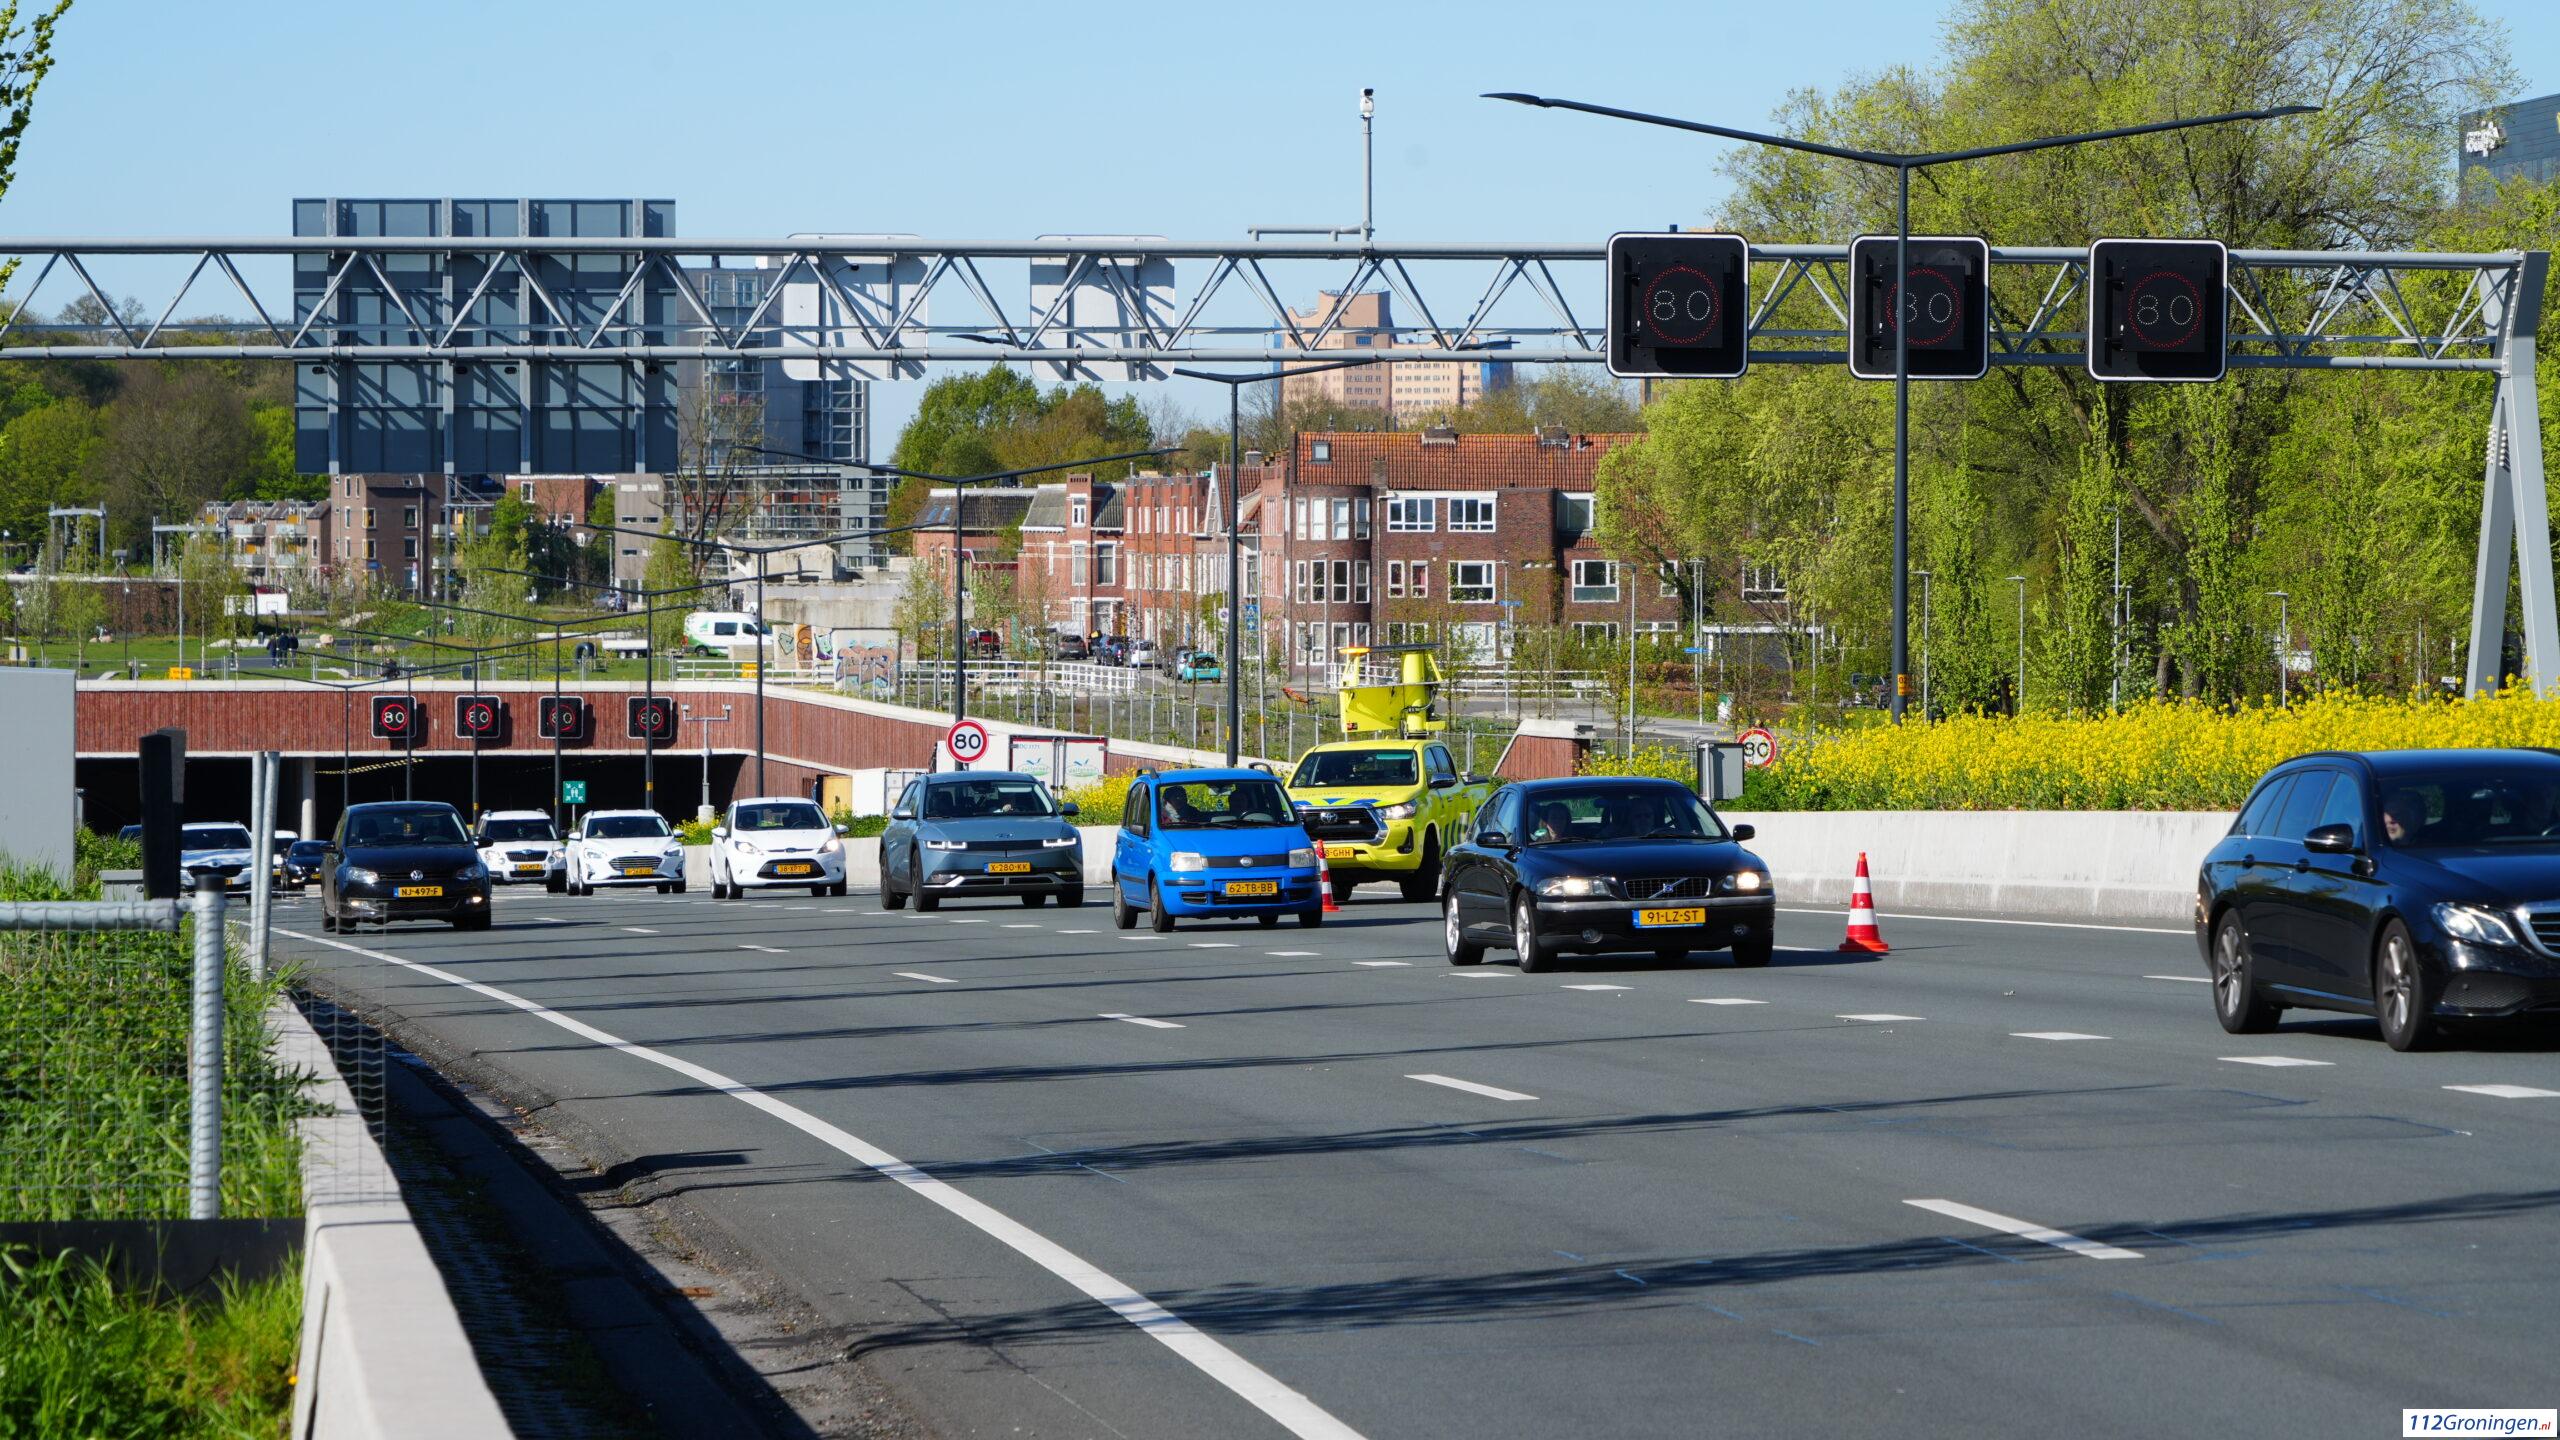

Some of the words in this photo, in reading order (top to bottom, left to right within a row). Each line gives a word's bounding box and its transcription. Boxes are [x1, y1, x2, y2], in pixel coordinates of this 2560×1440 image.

[1653, 290, 1710, 321] 80
[1897, 292, 1952, 323] 80
[2137, 294, 2194, 326] 80
[384, 712, 405, 723] 80
[468, 712, 489, 724] 80
[639, 712, 660, 725] 80
[954, 733, 982, 750] 80
[1744, 741, 1770, 758] 80
[990, 863, 1028, 872] X-280-KK
[401, 887, 439, 896] NJ-497-F
[1229, 883, 1273, 893] 62-TB-BB
[1647, 910, 1699, 923] 91-LZ-ST
